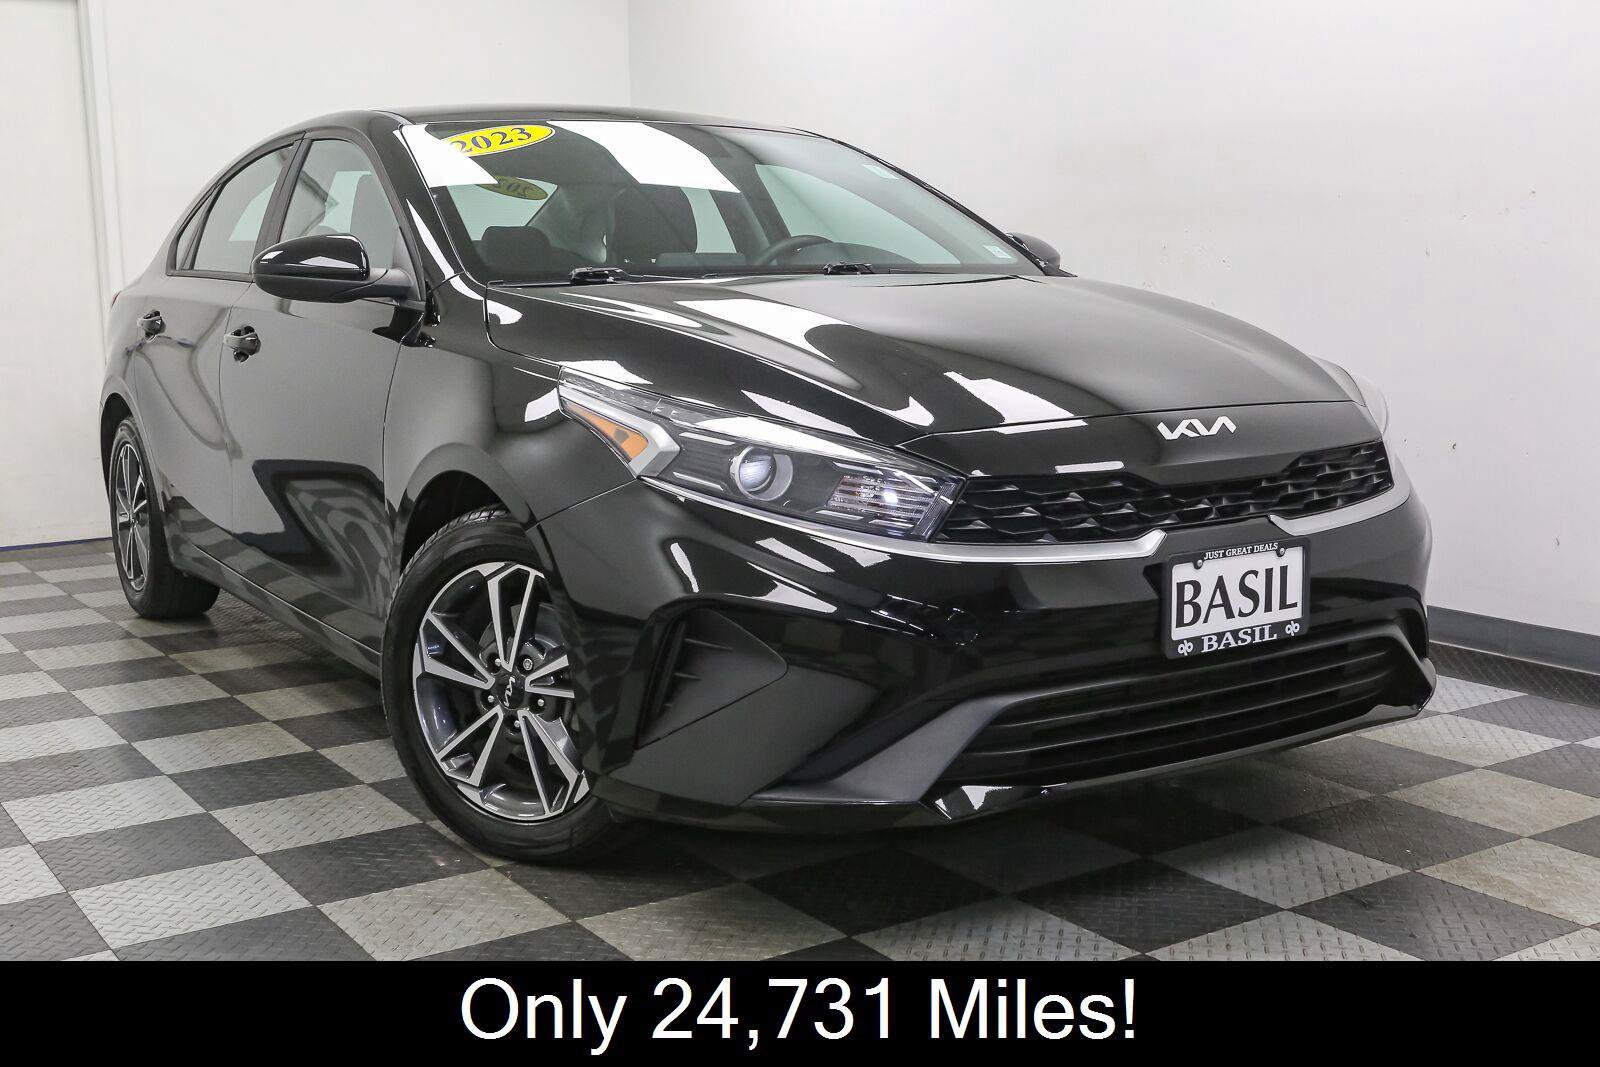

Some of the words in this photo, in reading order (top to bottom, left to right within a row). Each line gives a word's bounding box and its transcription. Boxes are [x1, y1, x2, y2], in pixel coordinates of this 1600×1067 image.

[450, 127, 532, 153] 2023
[1156, 415, 1237, 441] KIA
[1203, 550, 1225, 560] JUST
[1225, 546, 1253, 557] GREAT
[1253, 542, 1279, 553] DEALS
[1175, 565, 1298, 629] BASIL
[1200, 624, 1278, 653] BASIL
